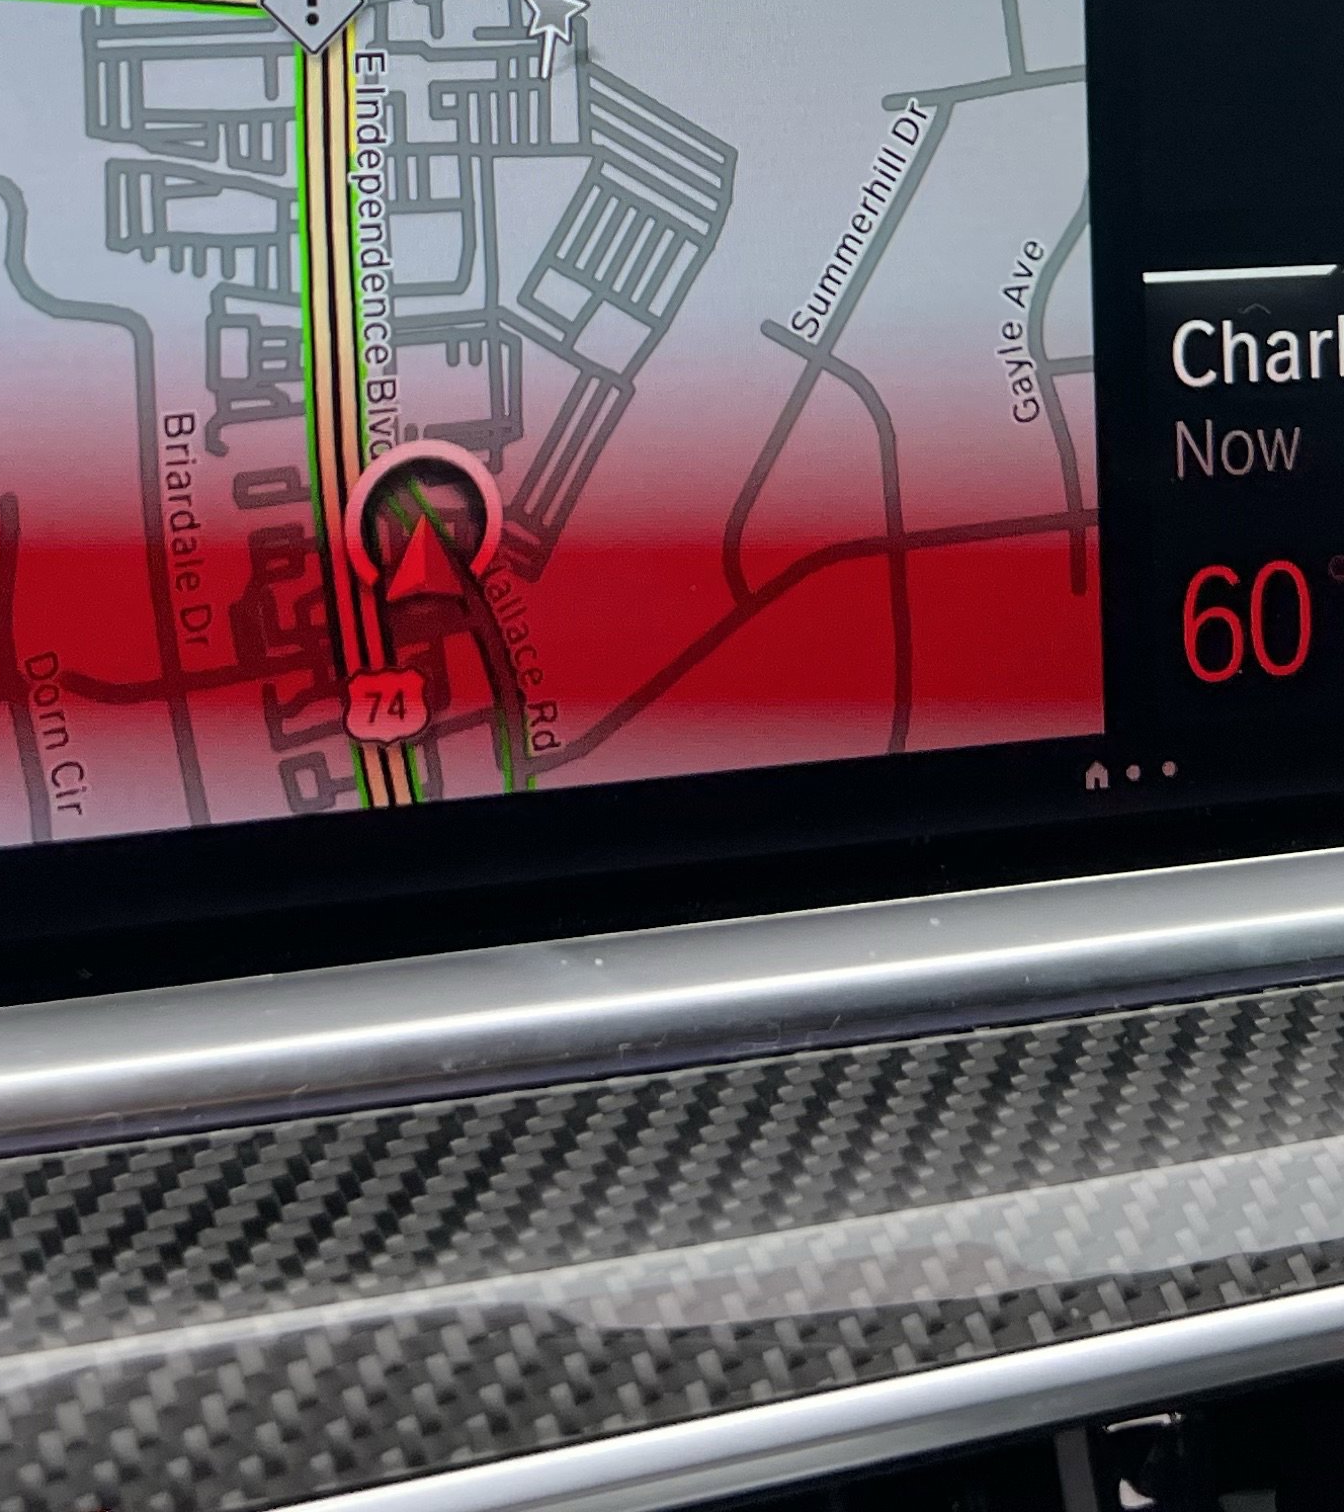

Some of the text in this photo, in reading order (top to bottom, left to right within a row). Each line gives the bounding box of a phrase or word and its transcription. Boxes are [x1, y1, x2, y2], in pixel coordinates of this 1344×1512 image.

[355, 51, 386, 74] E
[352, 87, 392, 365] Independence
[791, 100, 929, 340] Summerhill Dr
[997, 240, 1045, 424] Gayle Ave
[1174, 419, 1301, 481] Now
[163, 412, 213, 648] Briardale Dr
[1182, 559, 1312, 683] 60
[23, 650, 88, 817] Dorn Cir
[364, 688, 407, 725] 74
[526, 699, 561, 753] Rd
